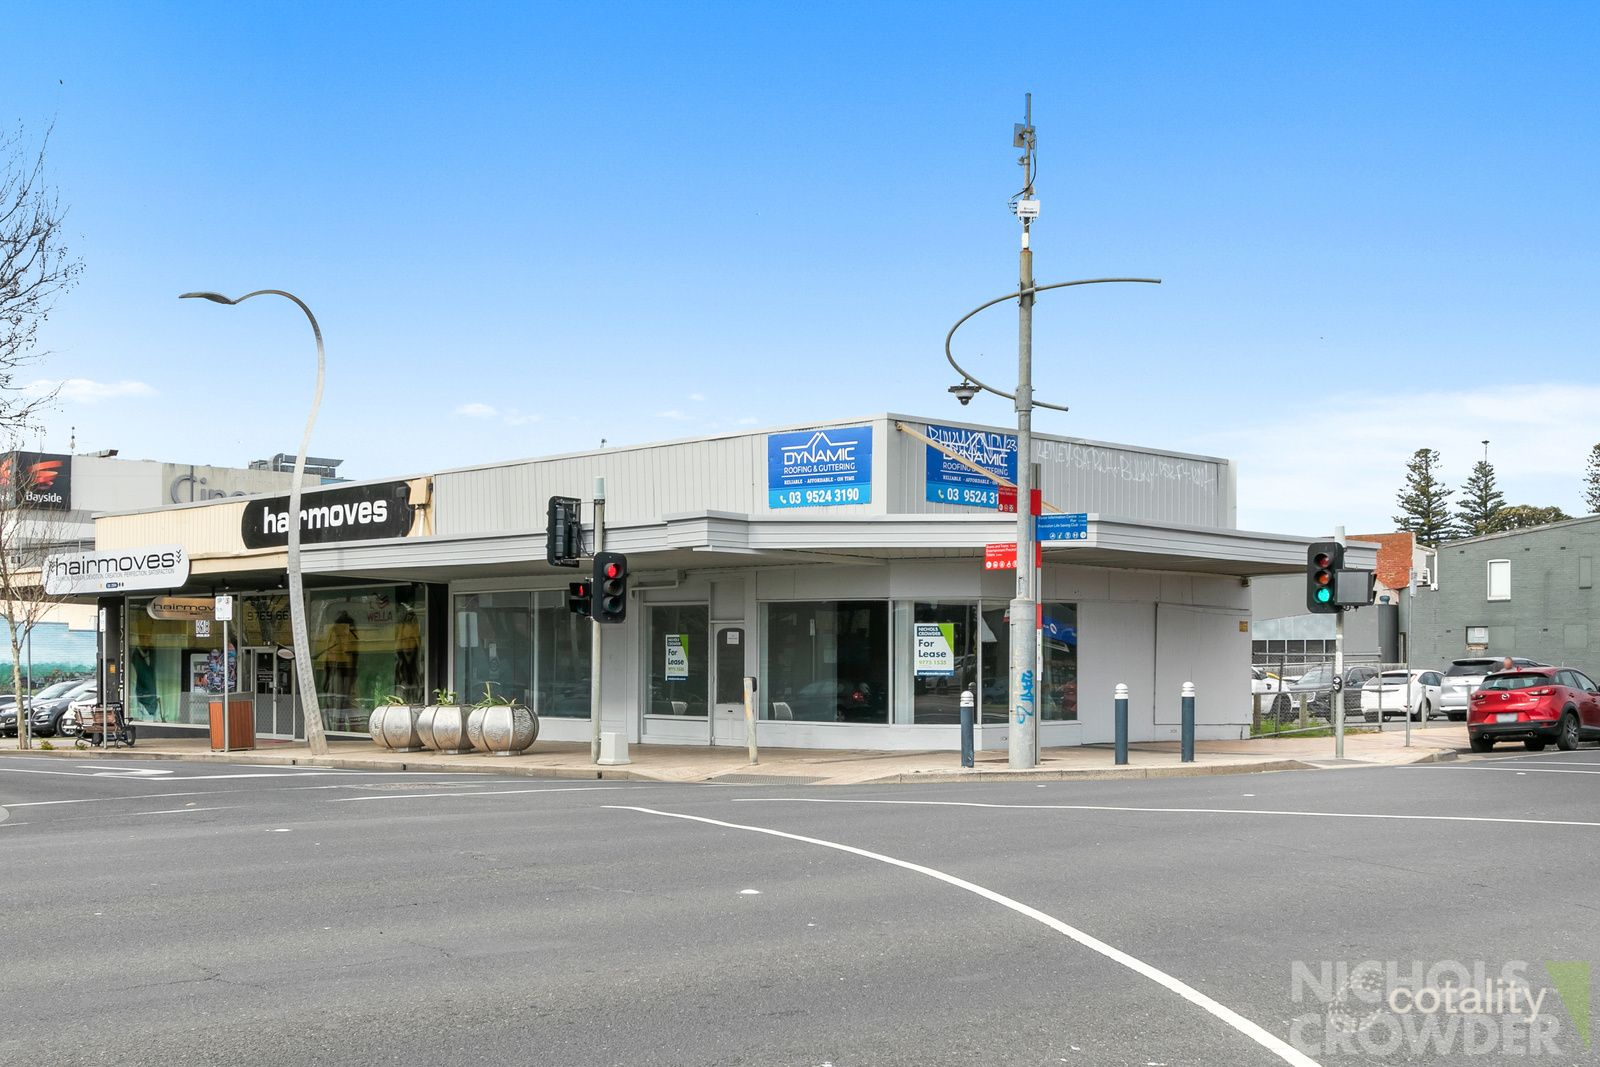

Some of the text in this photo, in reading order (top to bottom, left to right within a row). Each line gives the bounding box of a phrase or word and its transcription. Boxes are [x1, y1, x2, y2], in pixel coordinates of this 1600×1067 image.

[784, 448, 855, 465] DYNAMIC
[783, 462, 856, 474] ROOFING & GUTTERING
[26, 491, 62, 503] Bayside
[789, 488, 859, 504] 03 9524 3190
[947, 488, 959, 500] 03
[964, 489, 987, 503] 9524
[989, 492, 999, 505] 31
[263, 500, 388, 534] harmoves
[56, 552, 175, 576] hairmoves
[153, 603, 216, 612] hairmov
[918, 639, 935, 647] For
[668, 648, 678, 656] For
[918, 650, 947, 658] Lease
